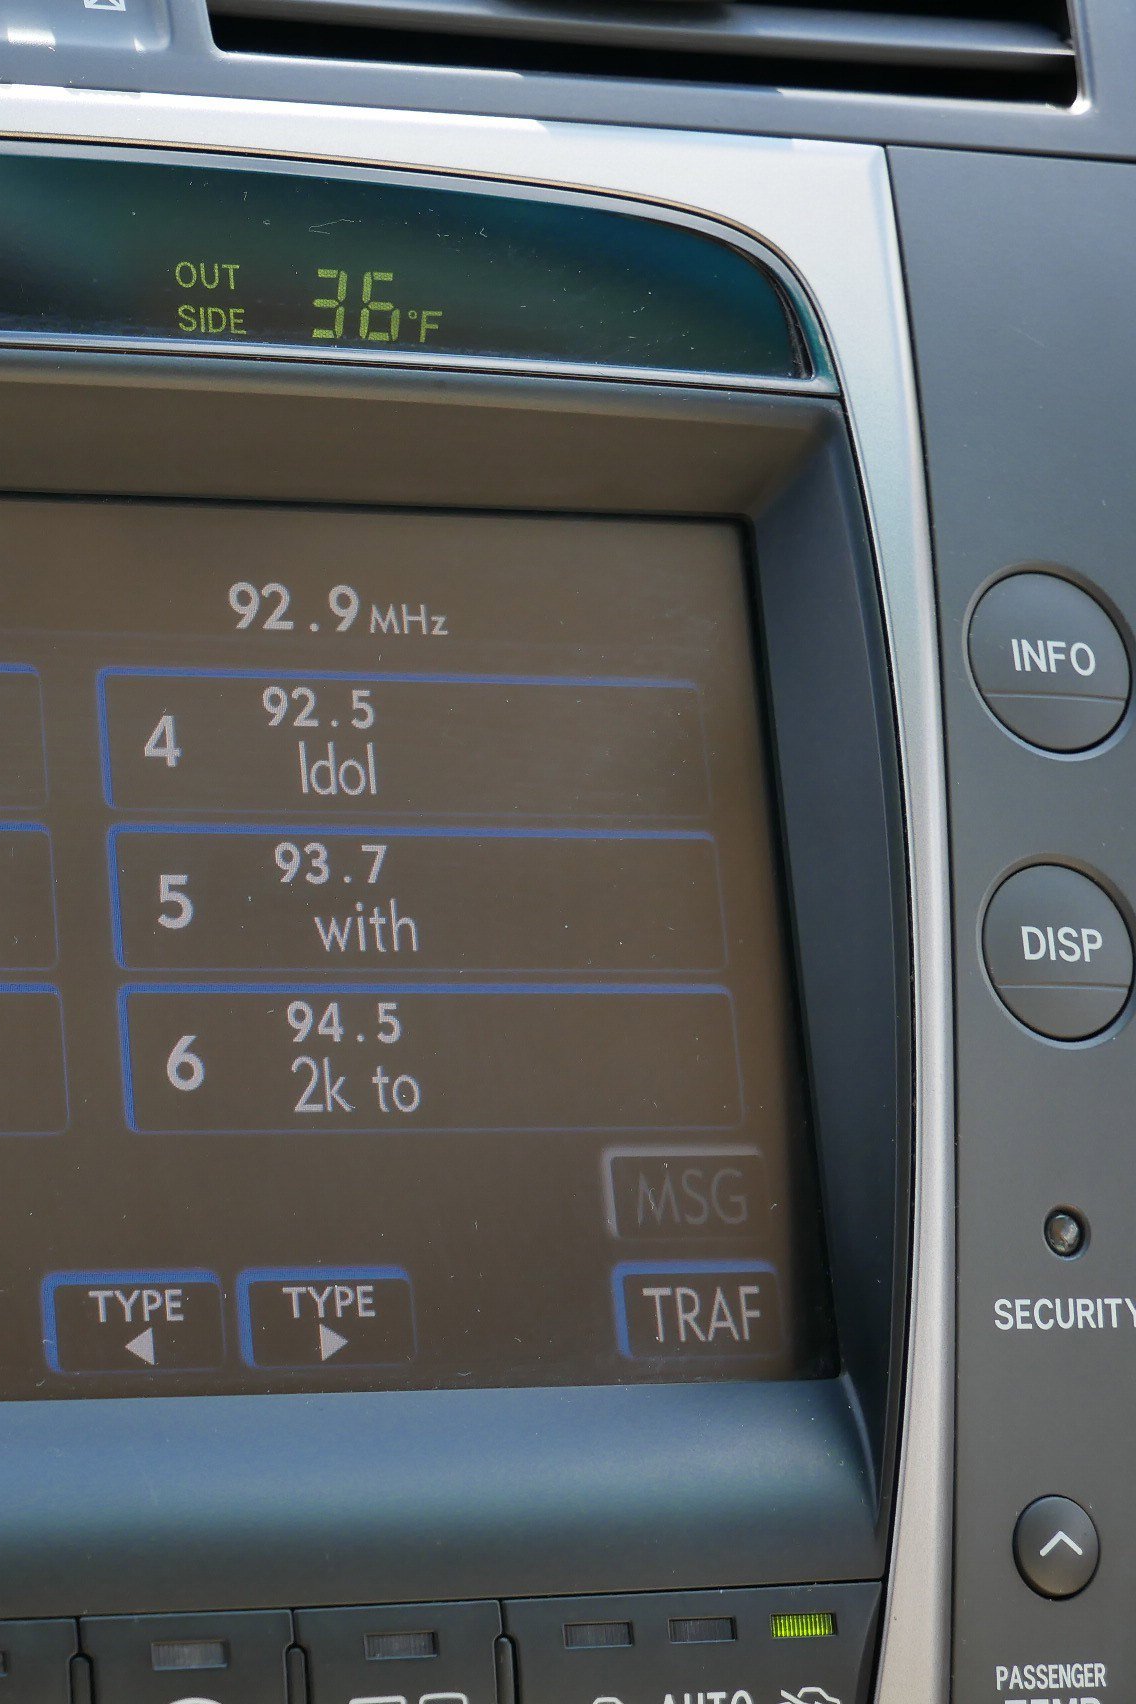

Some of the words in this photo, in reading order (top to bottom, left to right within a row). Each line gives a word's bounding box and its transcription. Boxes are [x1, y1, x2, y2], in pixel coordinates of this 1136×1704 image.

[175, 260, 240, 290] OUT
[177, 304, 248, 336] SIDE
[367, 603, 450, 636] MHz
[1010, 638, 1097, 677] INFO
[143, 714, 183, 768] 4
[157, 874, 195, 929] 5
[314, 898, 419, 953] with
[1021, 925, 1104, 964] DISP
[166, 1035, 205, 1092] 6
[291, 1057, 354, 1114] 2k
[372, 1065, 421, 1114] to
[636, 1168, 749, 1226] MSG
[88, 1289, 186, 1324] TYPE
[281, 1285, 377, 1320] TYPE
[642, 1286, 762, 1344] TRAF
[995, 1662, 1108, 1691] PASSENGER
